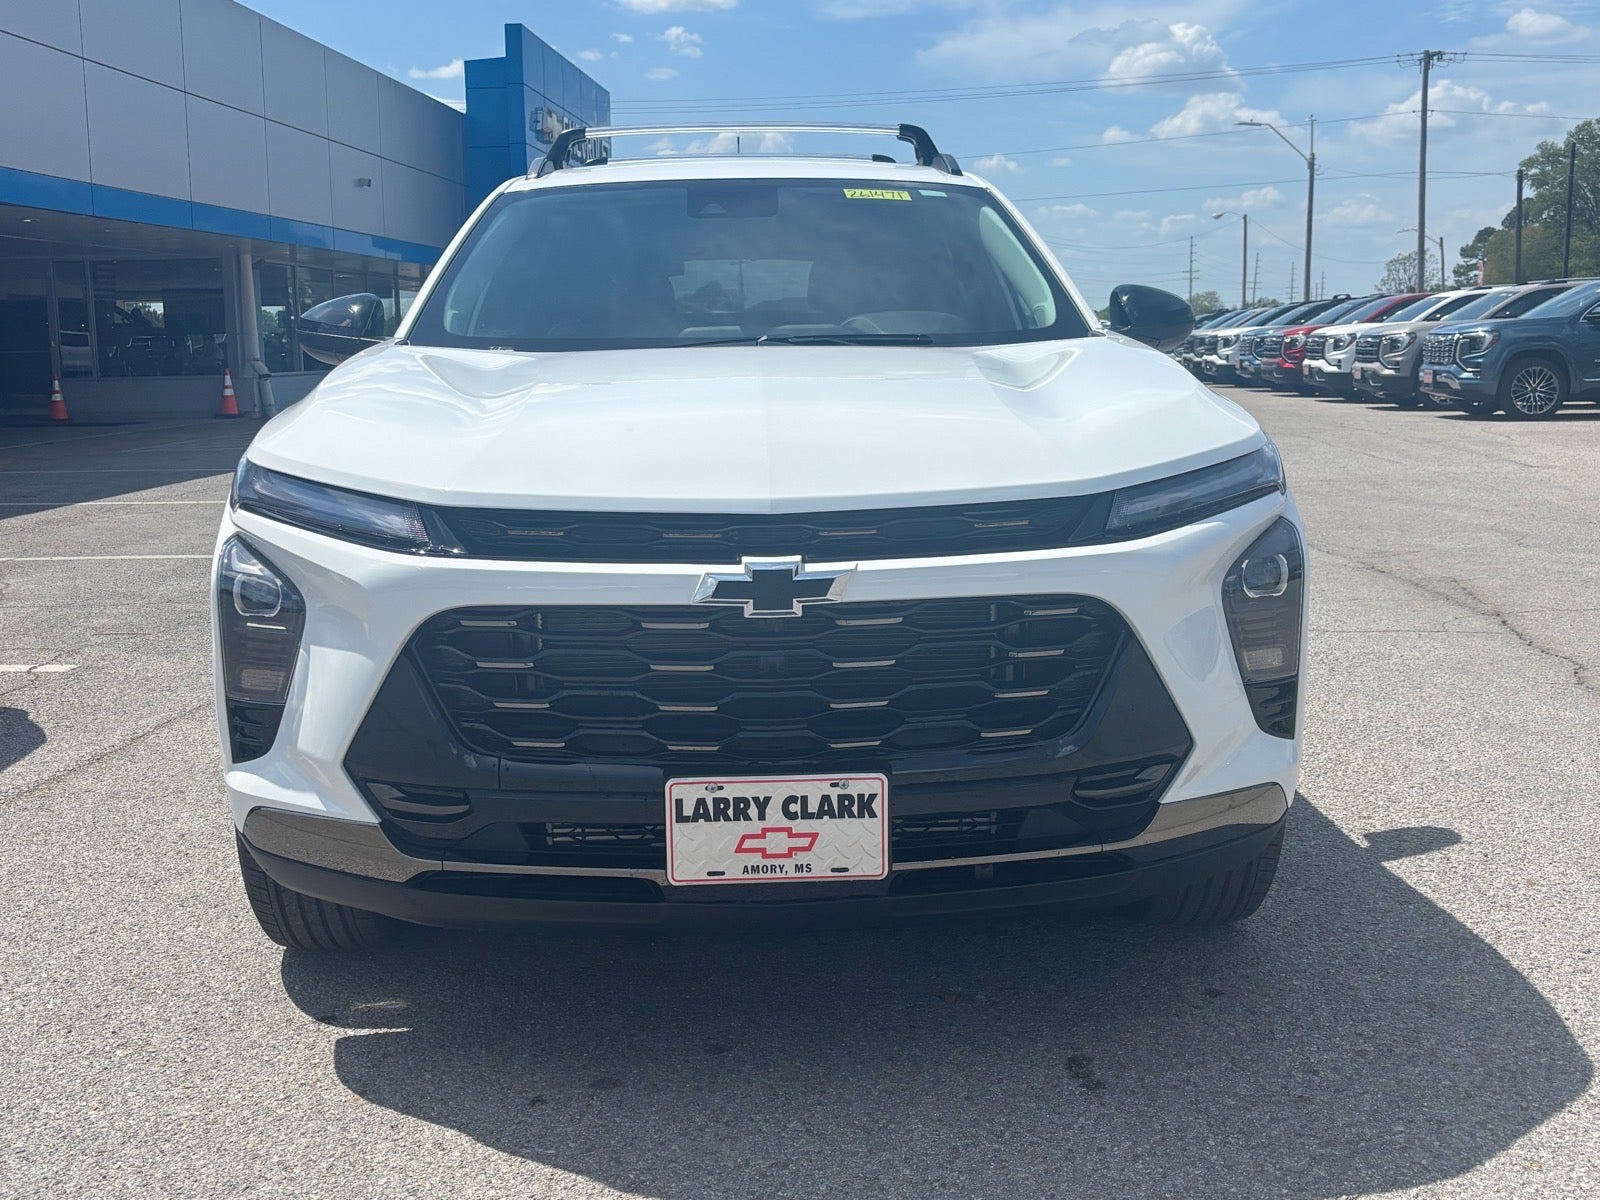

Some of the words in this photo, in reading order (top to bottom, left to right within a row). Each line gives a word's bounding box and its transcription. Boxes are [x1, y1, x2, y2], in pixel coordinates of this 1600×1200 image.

[674, 795, 773, 824] LARRY
[781, 793, 879, 821] CLARK
[742, 864, 788, 876] AMORY,
[794, 863, 812, 873] MS
